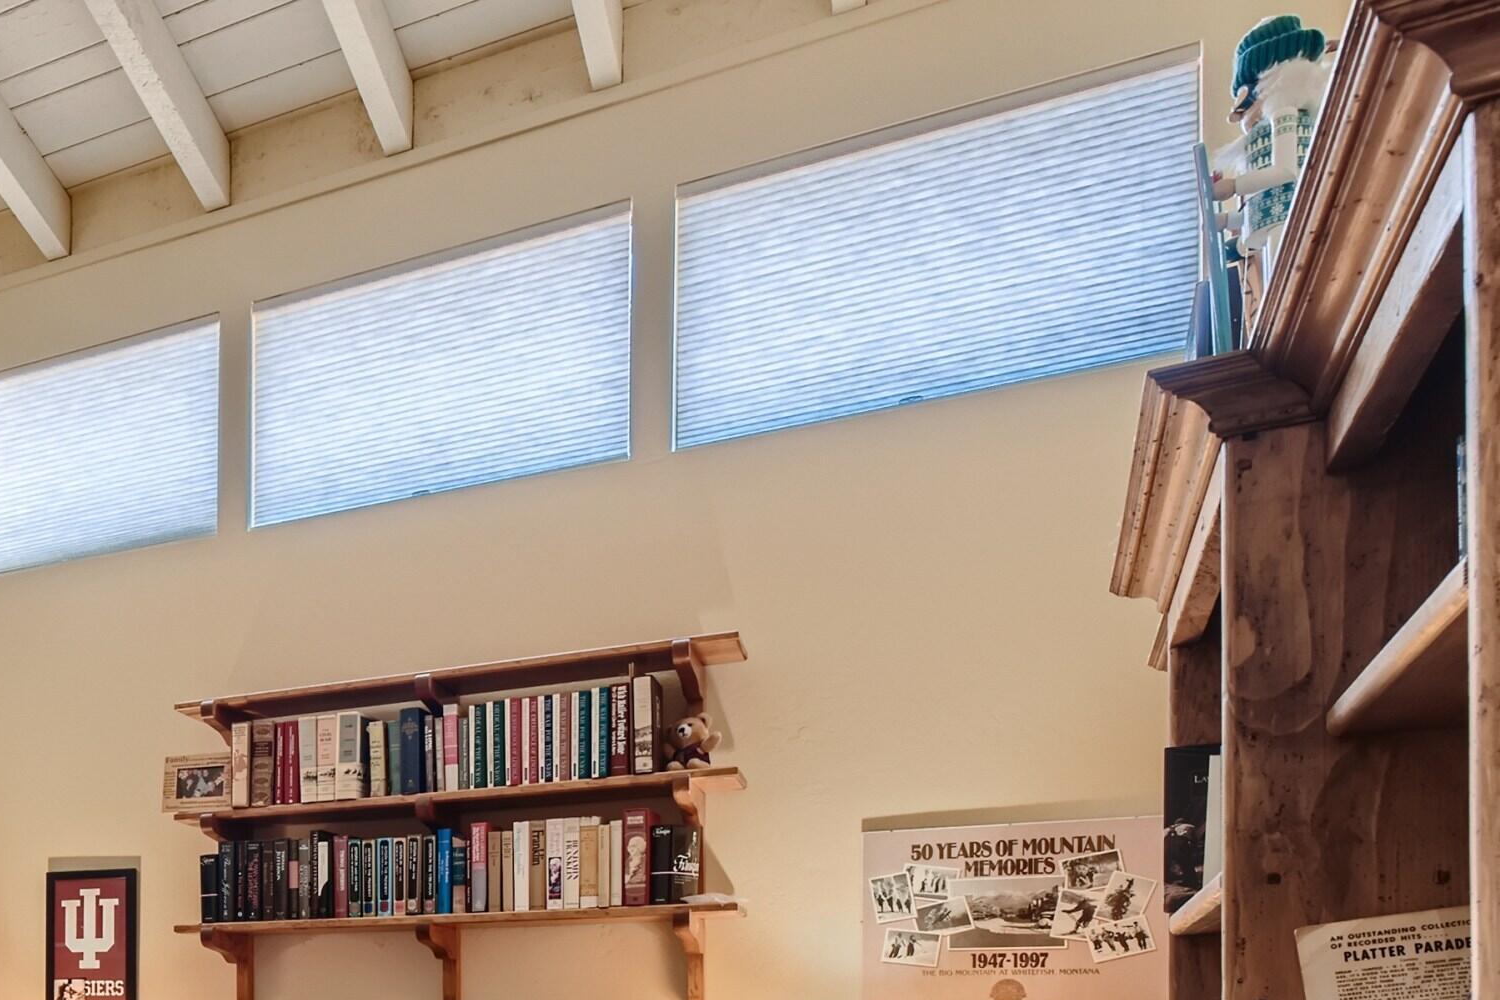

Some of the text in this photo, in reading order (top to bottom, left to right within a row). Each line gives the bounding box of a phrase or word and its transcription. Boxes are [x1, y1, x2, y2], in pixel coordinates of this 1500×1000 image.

[531, 829, 545, 866] Franklin
[910, 834, 1116, 861] 50 YEARS OF MOUNTAIN
[964, 857, 1056, 877] MEMORIES
[60, 887, 120, 970] IU
[1347, 925, 1417, 941] OUTSTANDING
[1343, 937, 1472, 963] PLATTER PARADE
[1347, 936, 1396, 948] RECORDED
[970, 952, 1049, 969] 1947-1997
[955, 968, 996, 976] MOUNTAIN
[999, 968, 1009, 976] AT
[1059, 968, 1101, 976] MONTANA
[84, 979, 125, 997] SIERS
